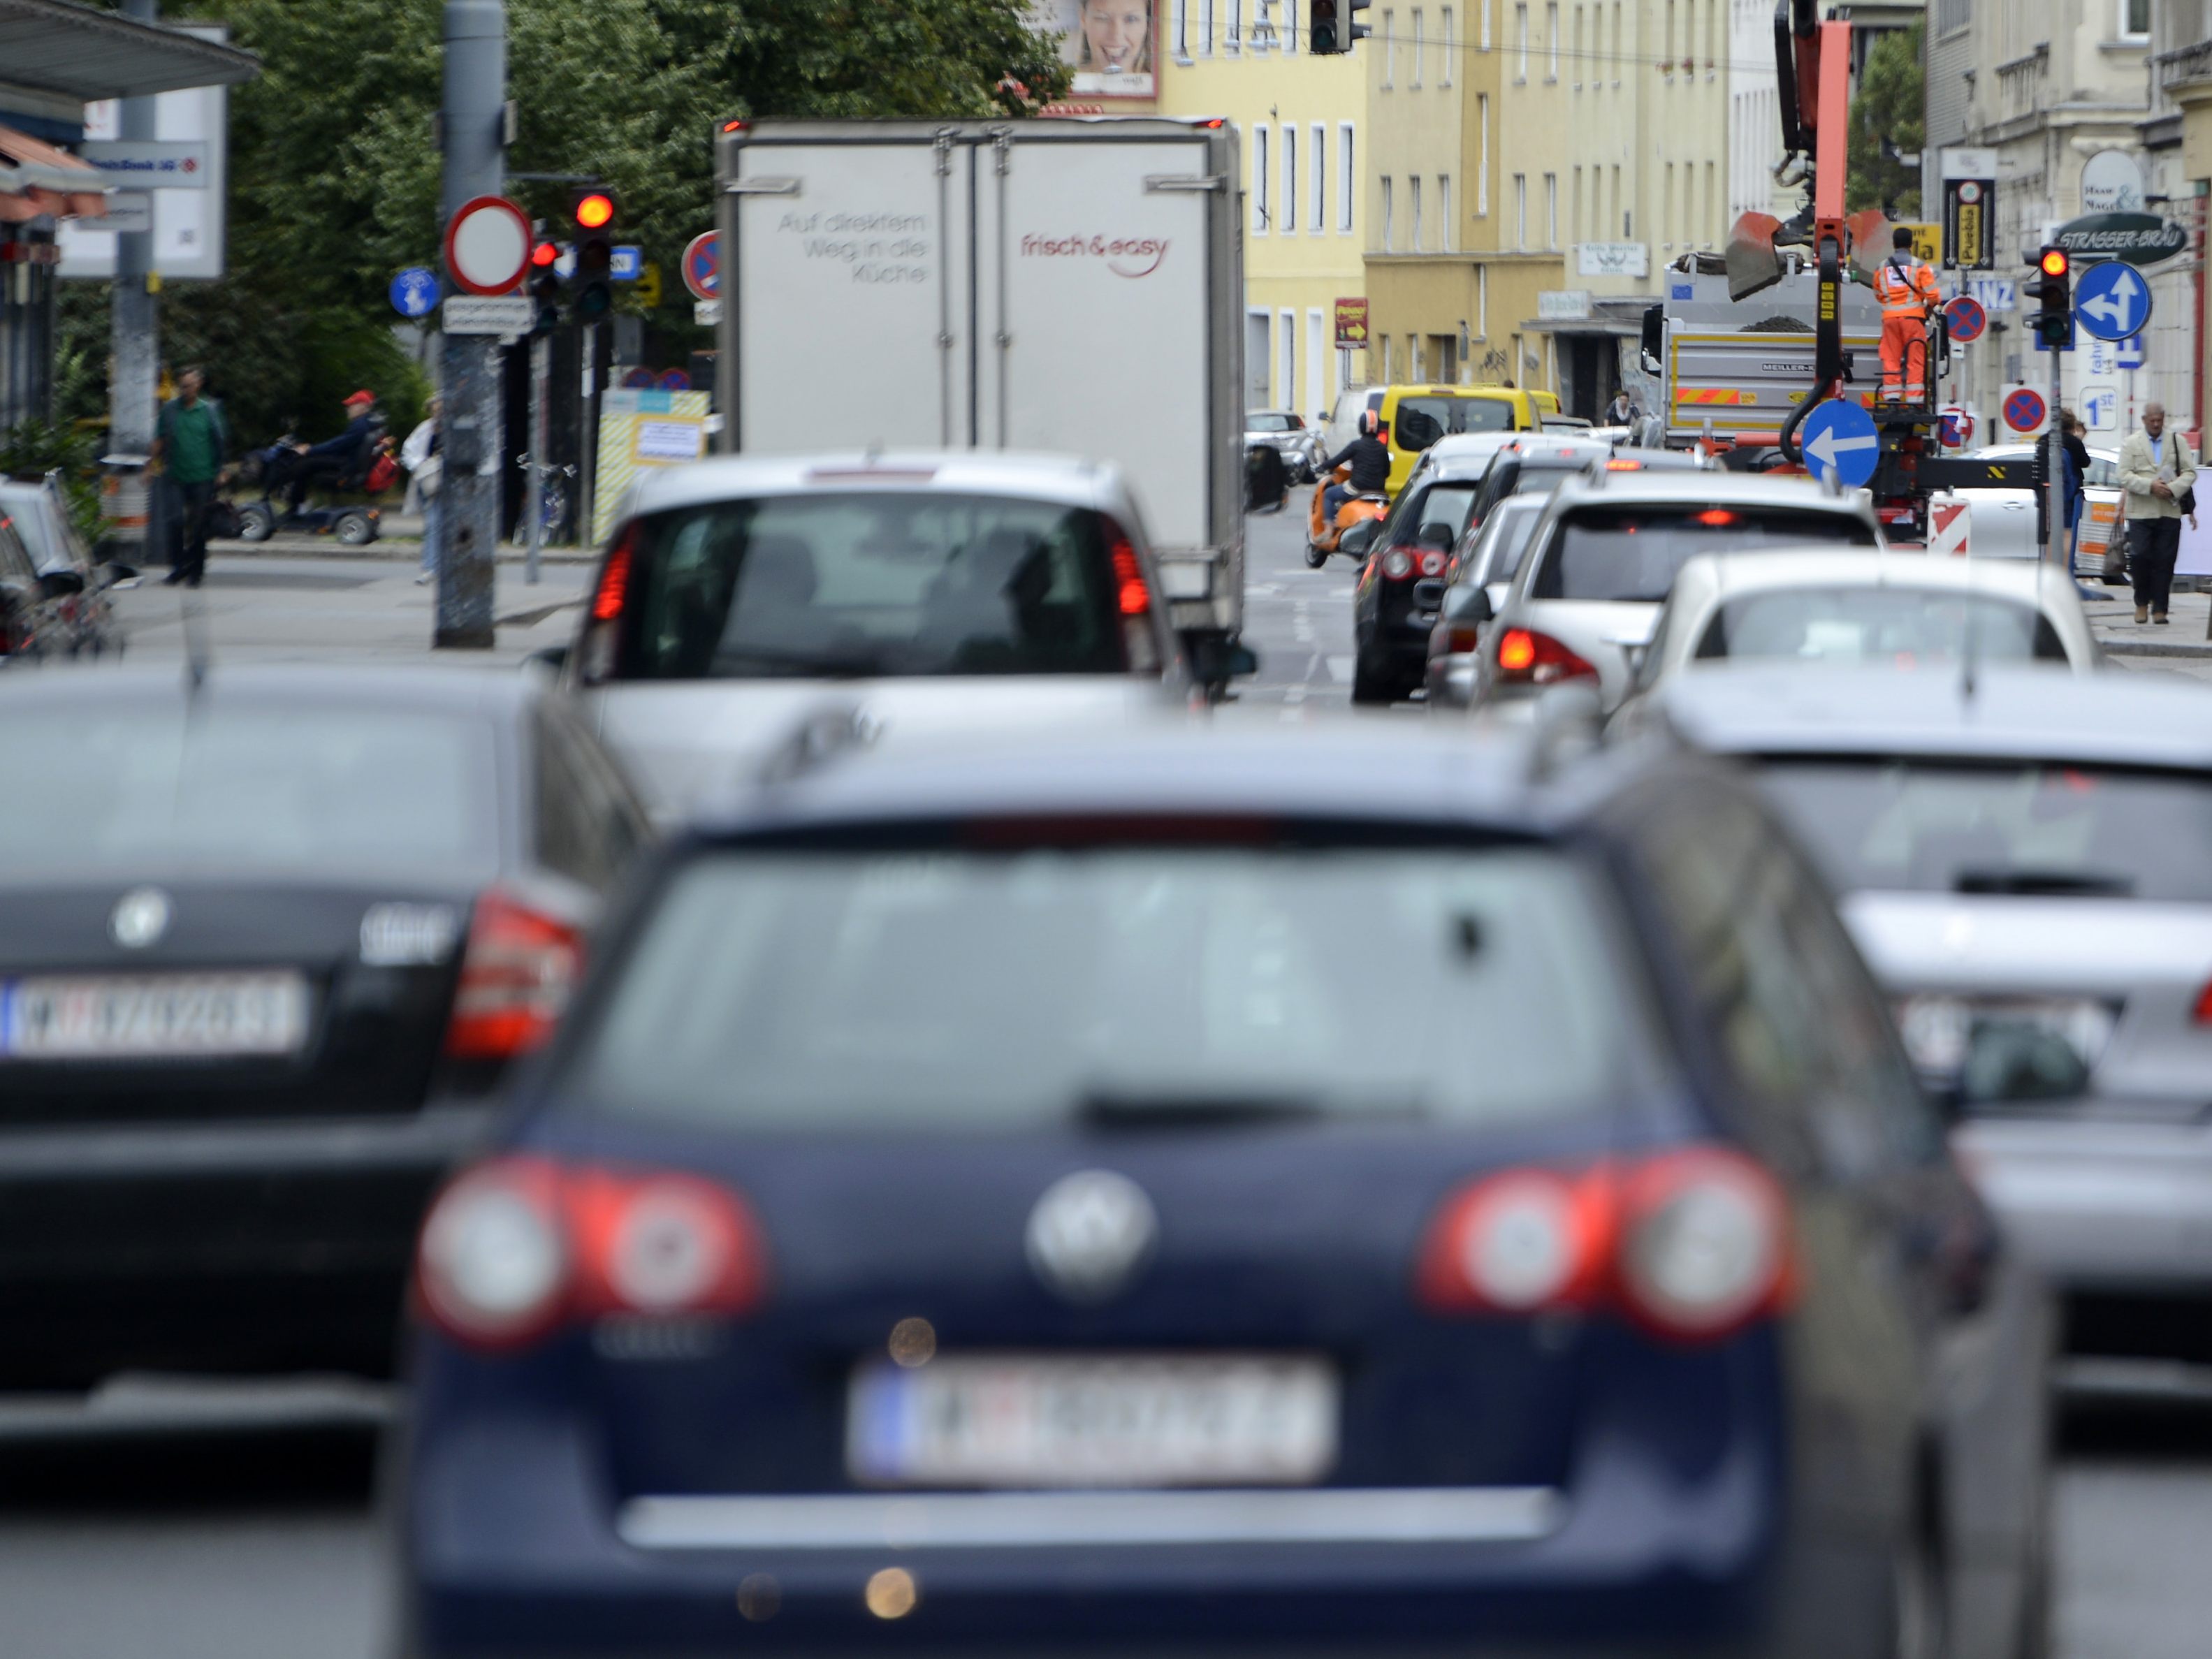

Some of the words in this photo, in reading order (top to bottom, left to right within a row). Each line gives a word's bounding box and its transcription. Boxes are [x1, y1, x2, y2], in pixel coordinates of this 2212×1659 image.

[778, 211, 820, 233] Auf
[824, 212, 926, 233] direktem
[803, 238, 857, 263] Weg
[864, 240, 882, 258] in
[889, 237, 928, 258] die
[1021, 231, 1085, 256] frisch
[1107, 237, 1172, 279] easy
[852, 263, 929, 284] Küche
